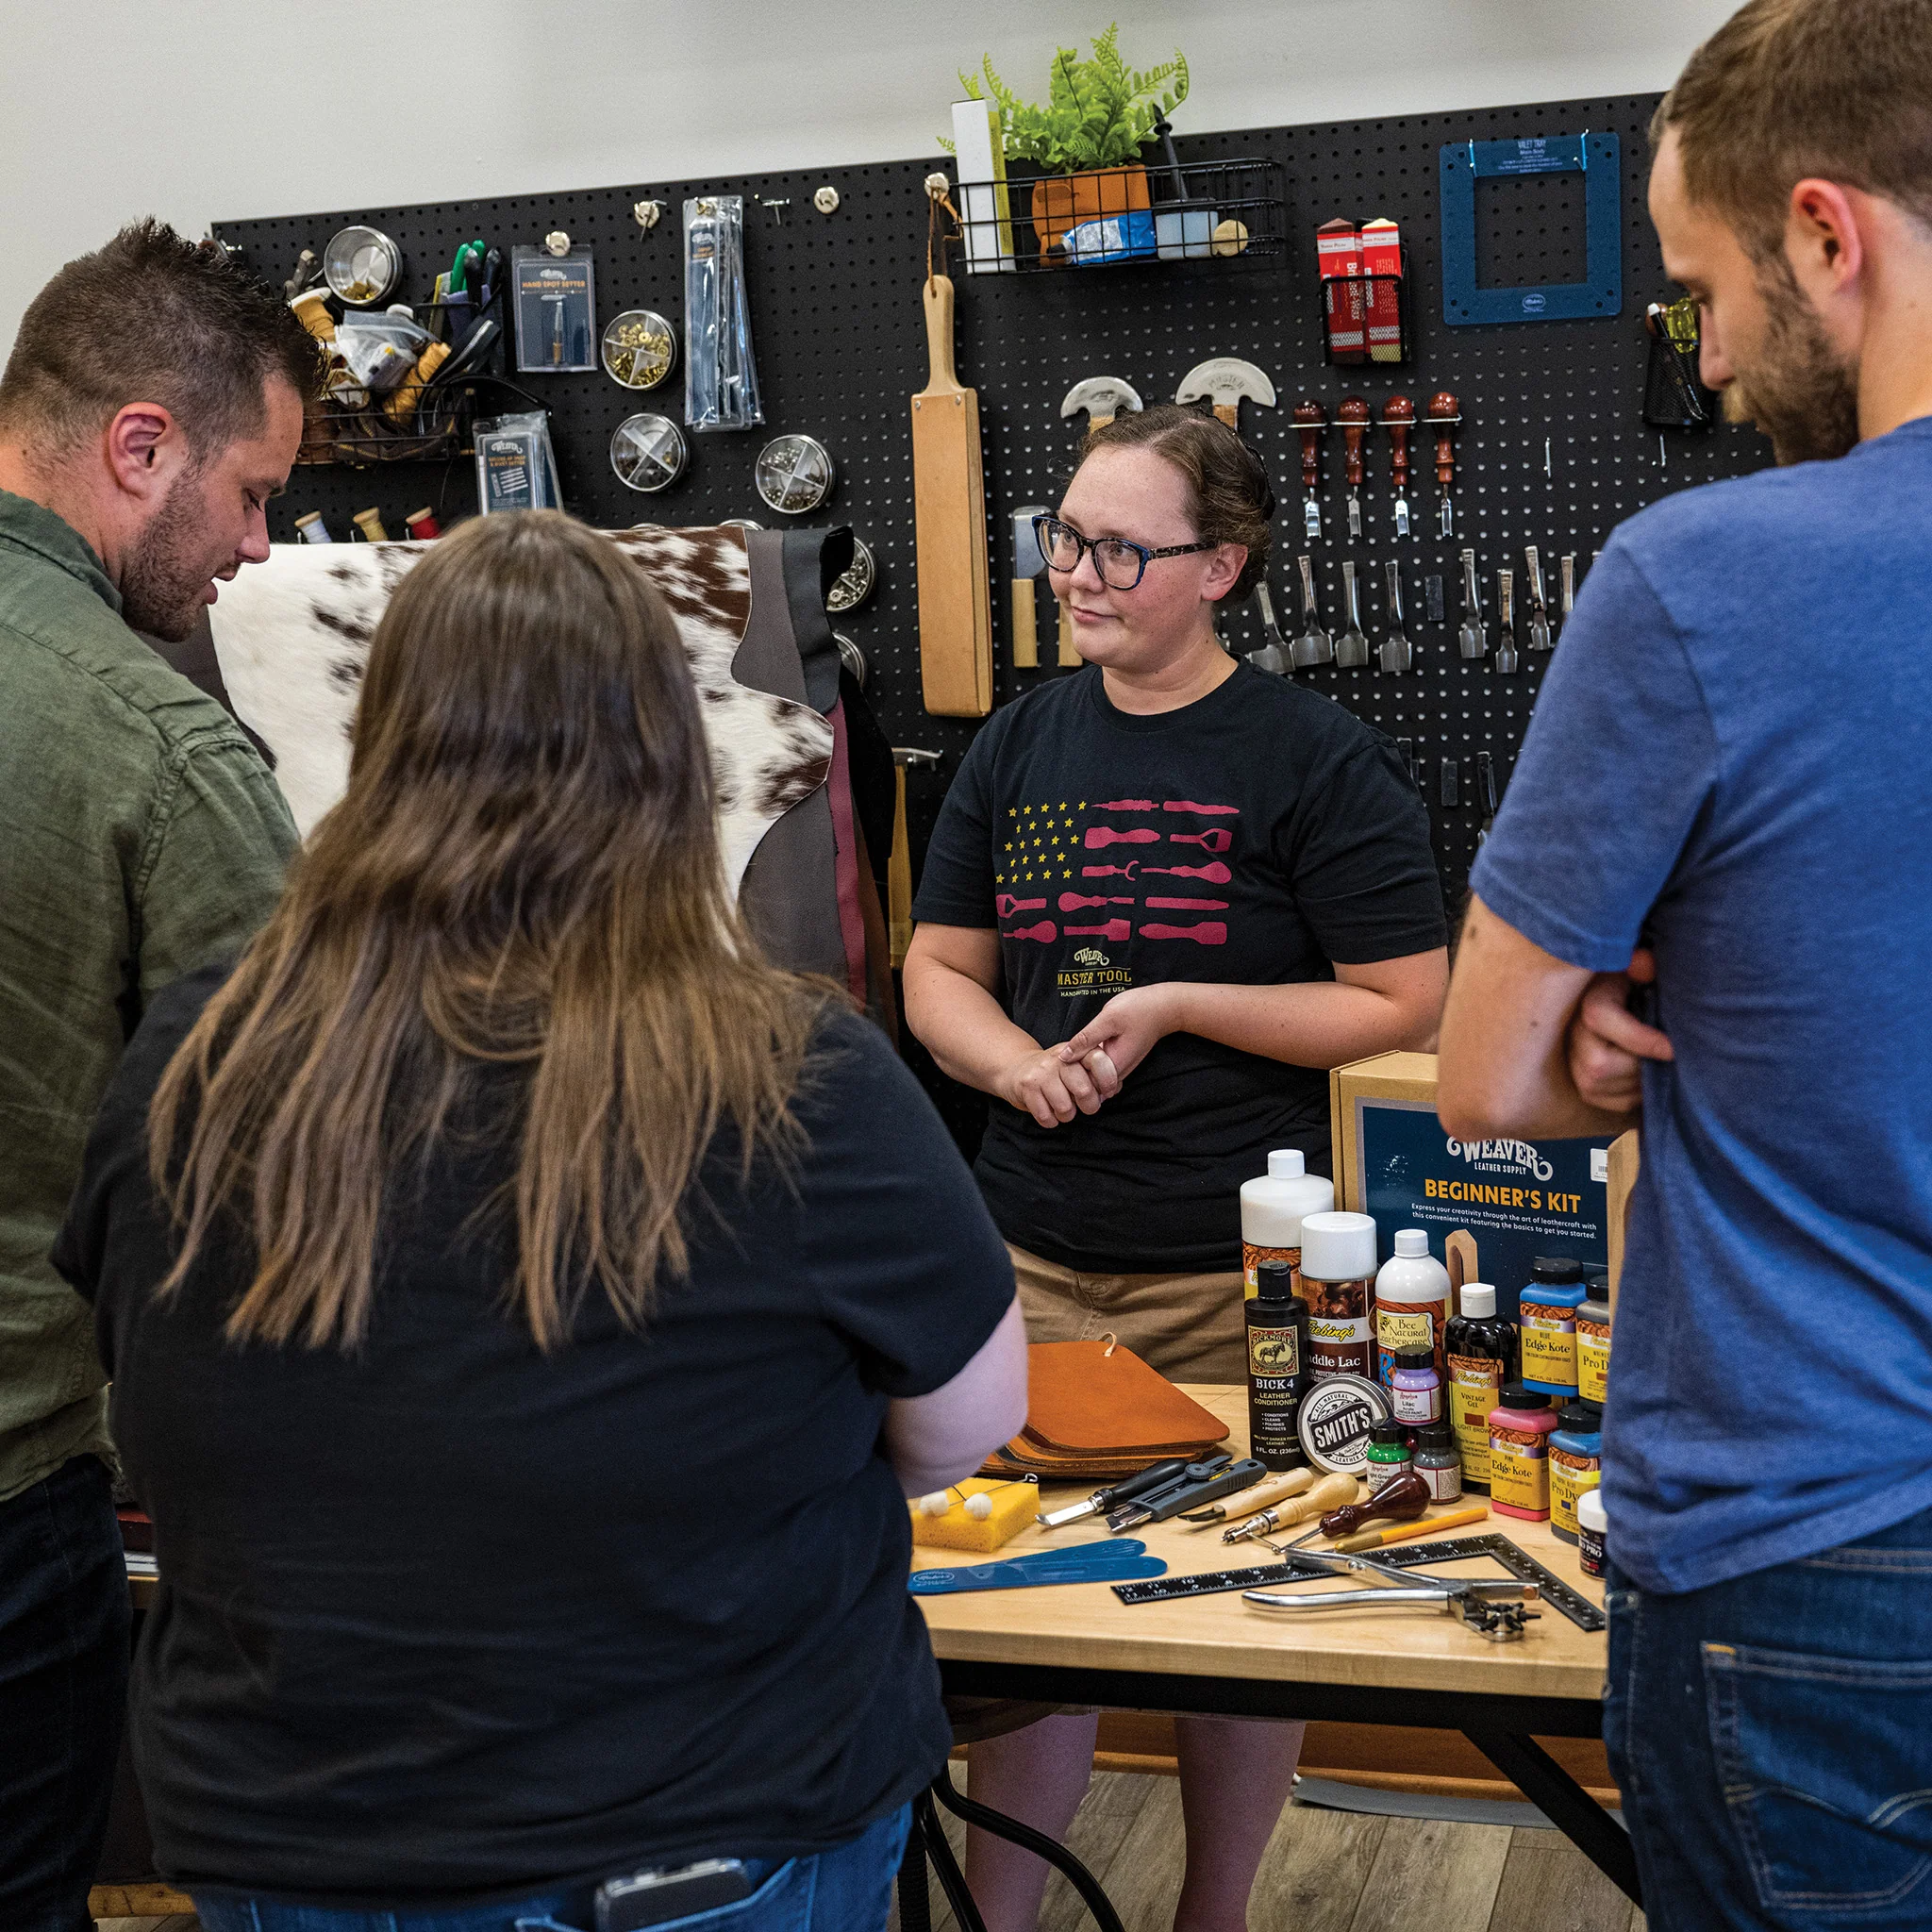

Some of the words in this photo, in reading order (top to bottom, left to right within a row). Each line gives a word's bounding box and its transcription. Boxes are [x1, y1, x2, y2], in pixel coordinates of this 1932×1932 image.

[1097, 970, 1132, 983] TOOL
[1446, 1138, 1554, 1181] WEAVER
[1474, 1162, 1501, 1173] LEATHER
[1503, 1165, 1526, 1175] SUPPLY
[1425, 1179, 1541, 1210] BEGINNER'S
[1548, 1192, 1581, 1214] KIT
[1412, 1203, 1435, 1212] Express
[1451, 1208, 1481, 1217] creativity
[1483, 1211, 1508, 1220] through
[1541, 1217, 1580, 1228] leathercraft
[1425, 1213, 1459, 1223] convenient
[1471, 1218, 1500, 1228] featuring
[1514, 1223, 1534, 1231] basics
[1570, 1231, 1597, 1239] started.
[1308, 1320, 1355, 1342] Fiebing's
[1390, 1325, 1427, 1337] Natural
[1399, 1319, 1416, 1330] Bee
[1525, 1338, 1547, 1352] Edge
[1549, 1341, 1570, 1354] Kote
[1308, 1354, 1335, 1366] ddle
[1338, 1356, 1361, 1367] Lac
[1583, 1355, 1599, 1368] Pro
[1254, 1398, 1298, 1407] CONDITIONER
[1315, 1403, 1324, 1413] ALL
[1324, 1393, 1349, 1403] NATURAL
[1461, 1392, 1486, 1402] VINTAGE
[1467, 1400, 1479, 1408] GEL
[1314, 1407, 1370, 1448] SMITH'S
[1457, 1423, 1472, 1432] LIGHT
[1492, 1459, 1510, 1474] Edge
[1512, 1466, 1532, 1478] Kote
[1552, 1481, 1565, 1497] Pro
